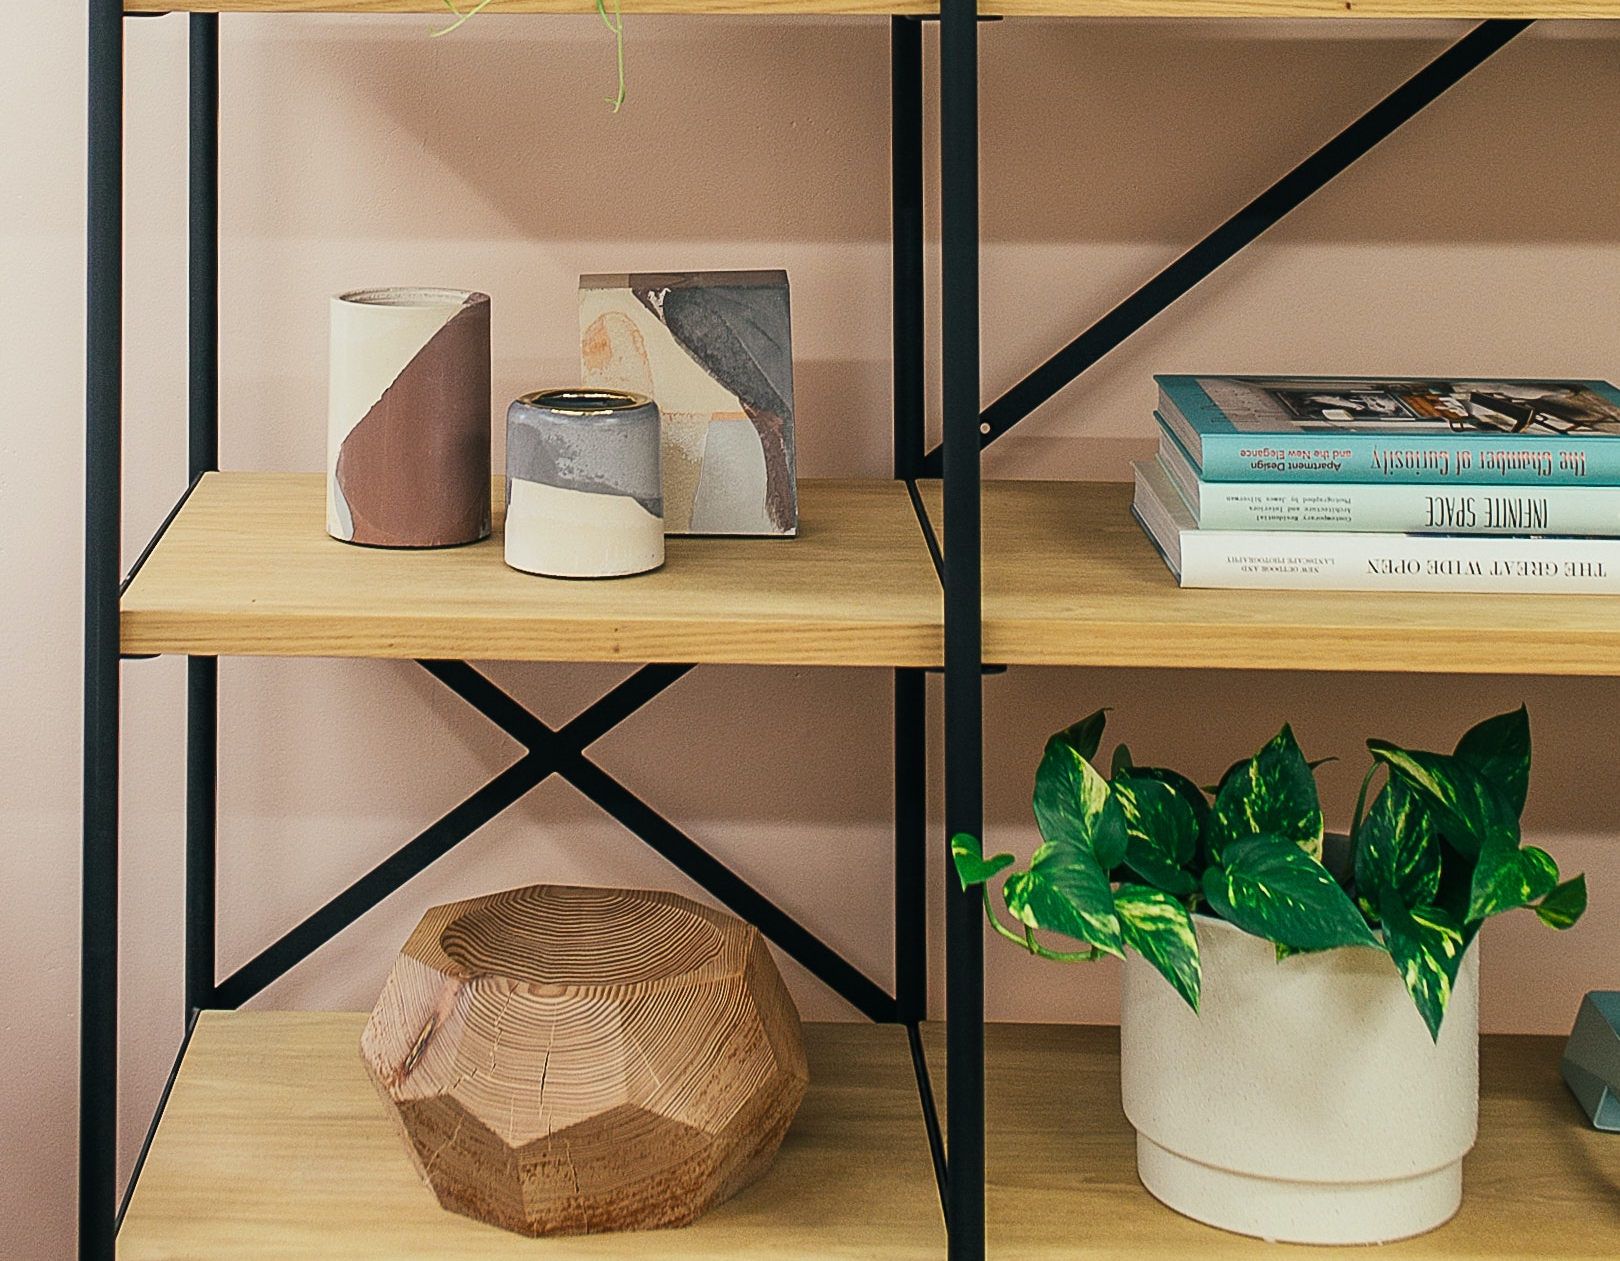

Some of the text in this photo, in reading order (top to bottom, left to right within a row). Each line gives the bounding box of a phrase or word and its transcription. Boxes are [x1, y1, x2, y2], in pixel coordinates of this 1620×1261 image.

[1240, 449, 1352, 460] and the New Elegance
[1250, 459, 1342, 472] Apartment Design
[1370, 445, 1587, 477] The Chamber of Curiosity
[1304, 506, 1352, 514] Architecture
[1424, 496, 1548, 529] INFINITE SPACE
[1302, 514, 1352, 522] Contemporary
[1226, 557, 1285, 565] PHOTOGRAPHY
[1261, 566, 1299, 574] OUTDOOR
[1301, 566, 1320, 574] NEW
[1364, 558, 1607, 578] THE GREAT WIDE OPEN
